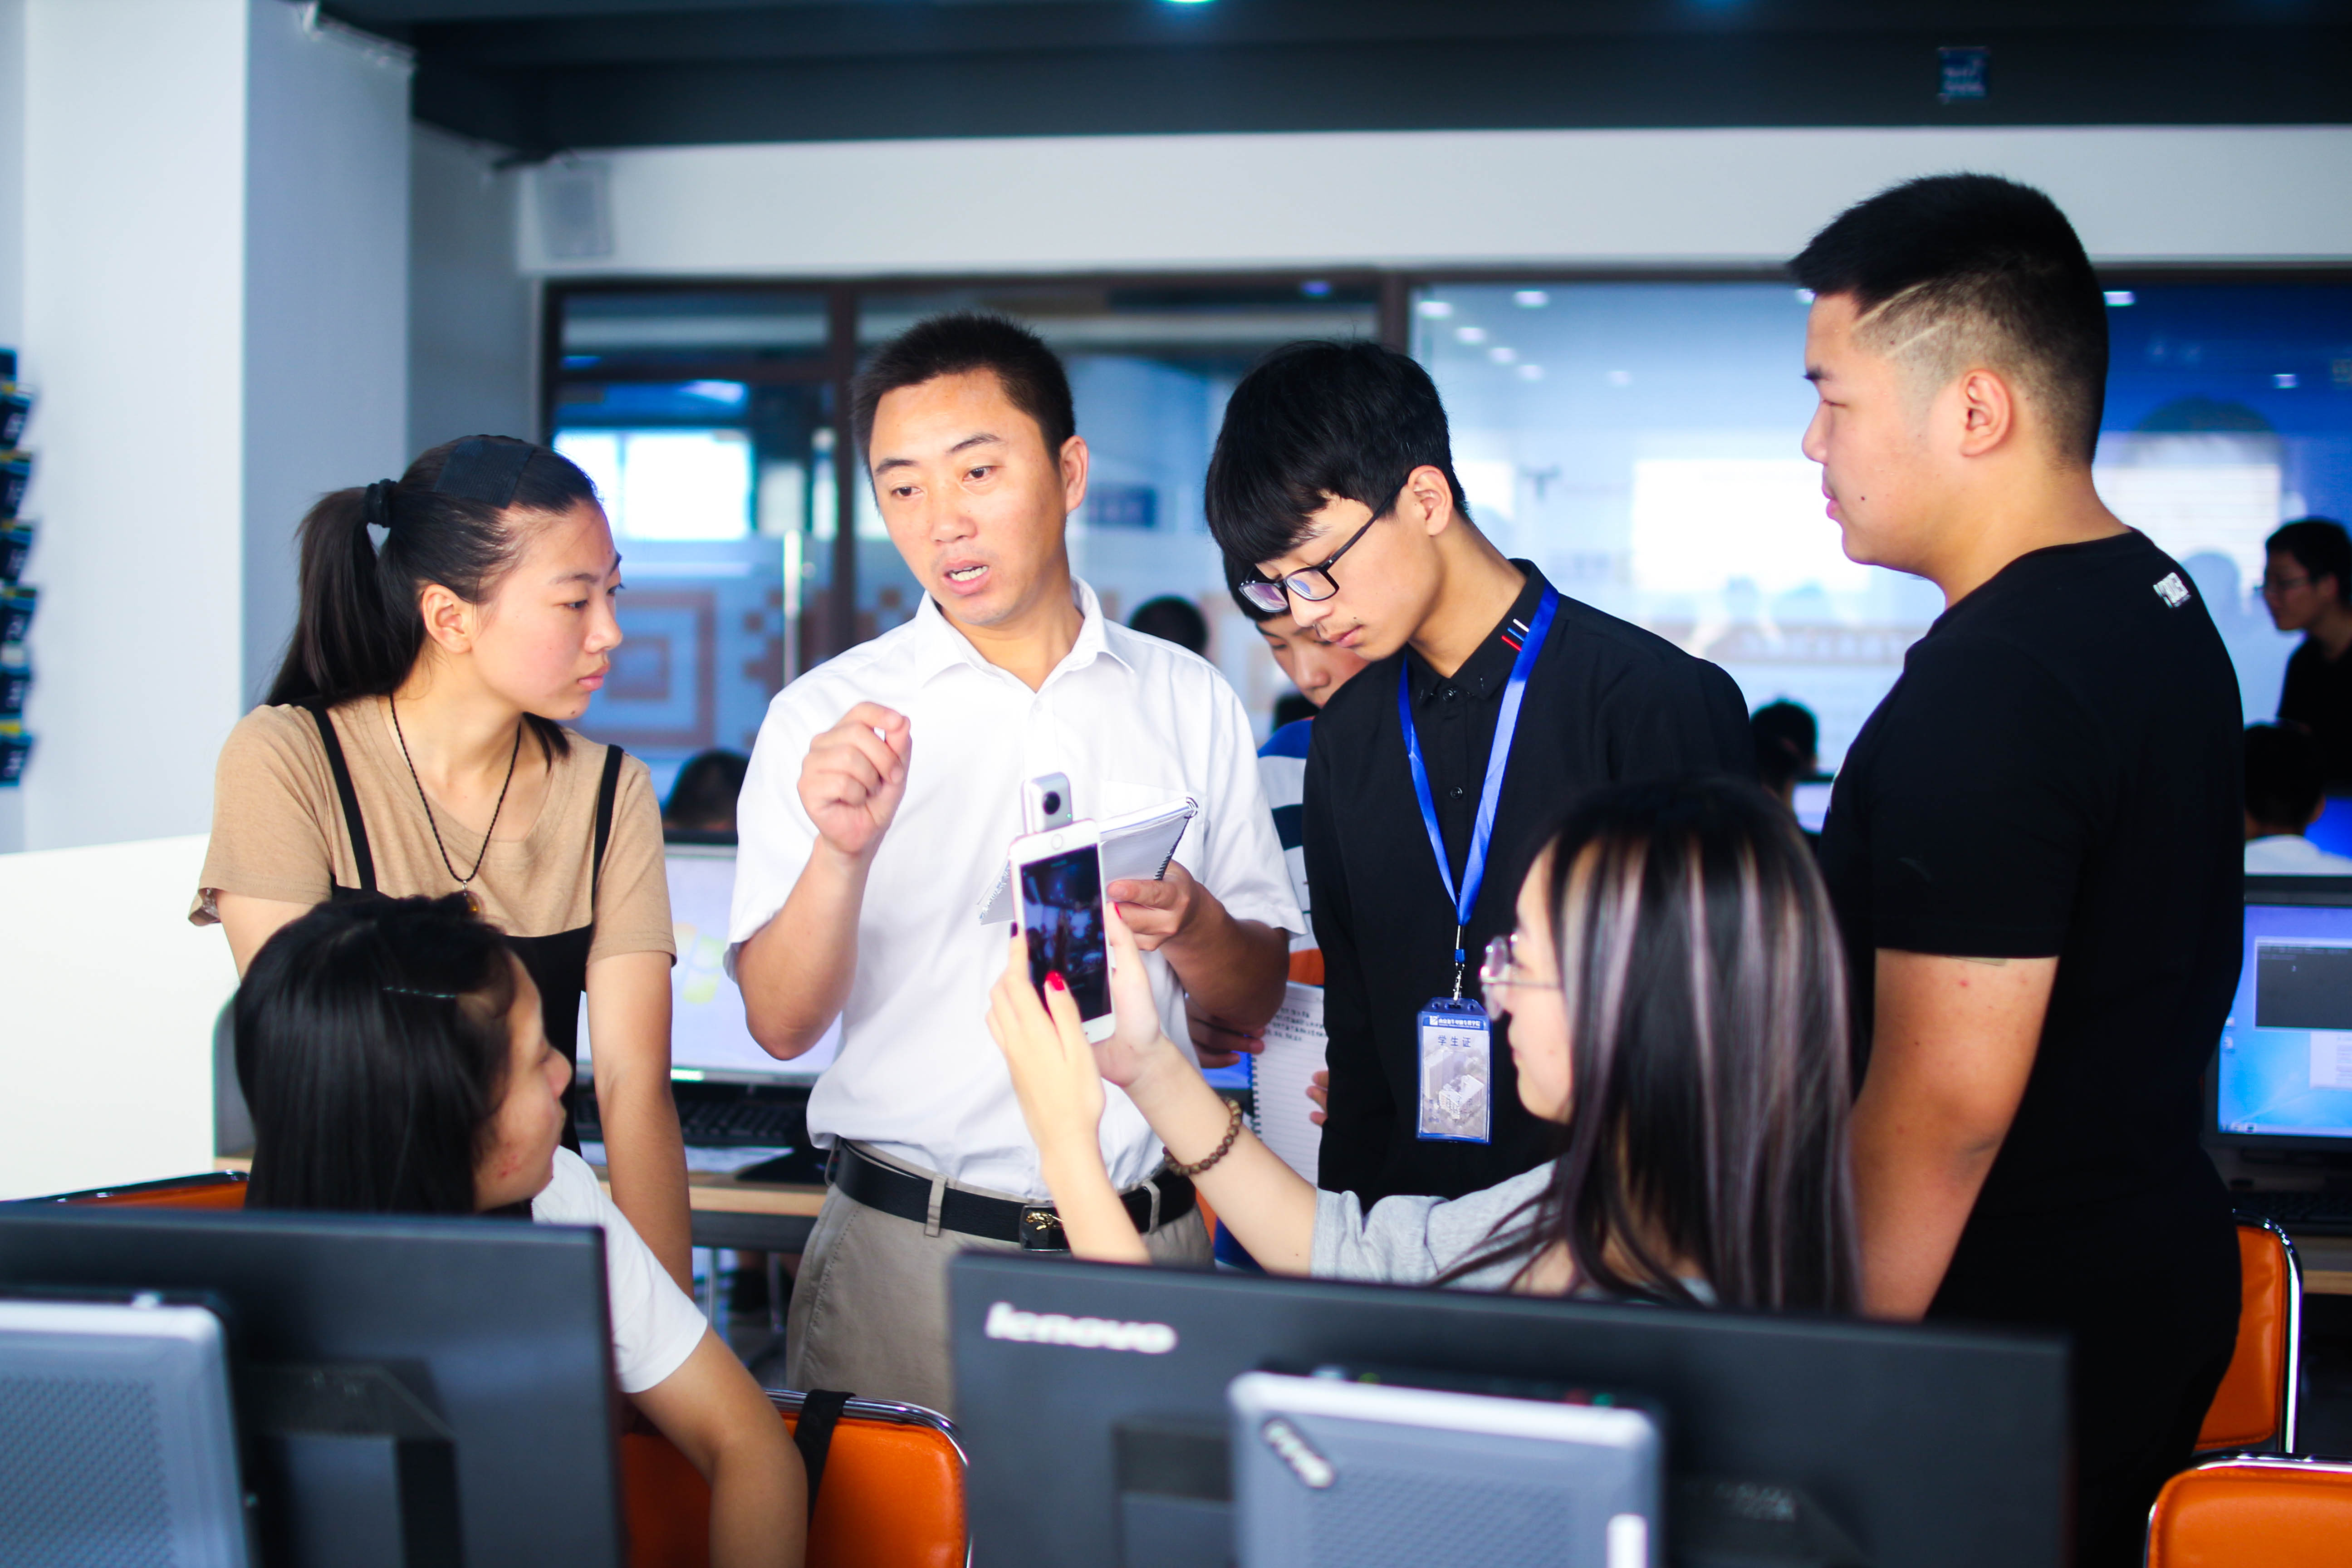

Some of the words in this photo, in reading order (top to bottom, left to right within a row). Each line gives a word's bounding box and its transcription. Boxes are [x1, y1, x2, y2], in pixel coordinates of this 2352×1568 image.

[1438, 1035, 1471, 1048] 学生证
[985, 1301, 1177, 1354] lenovo
